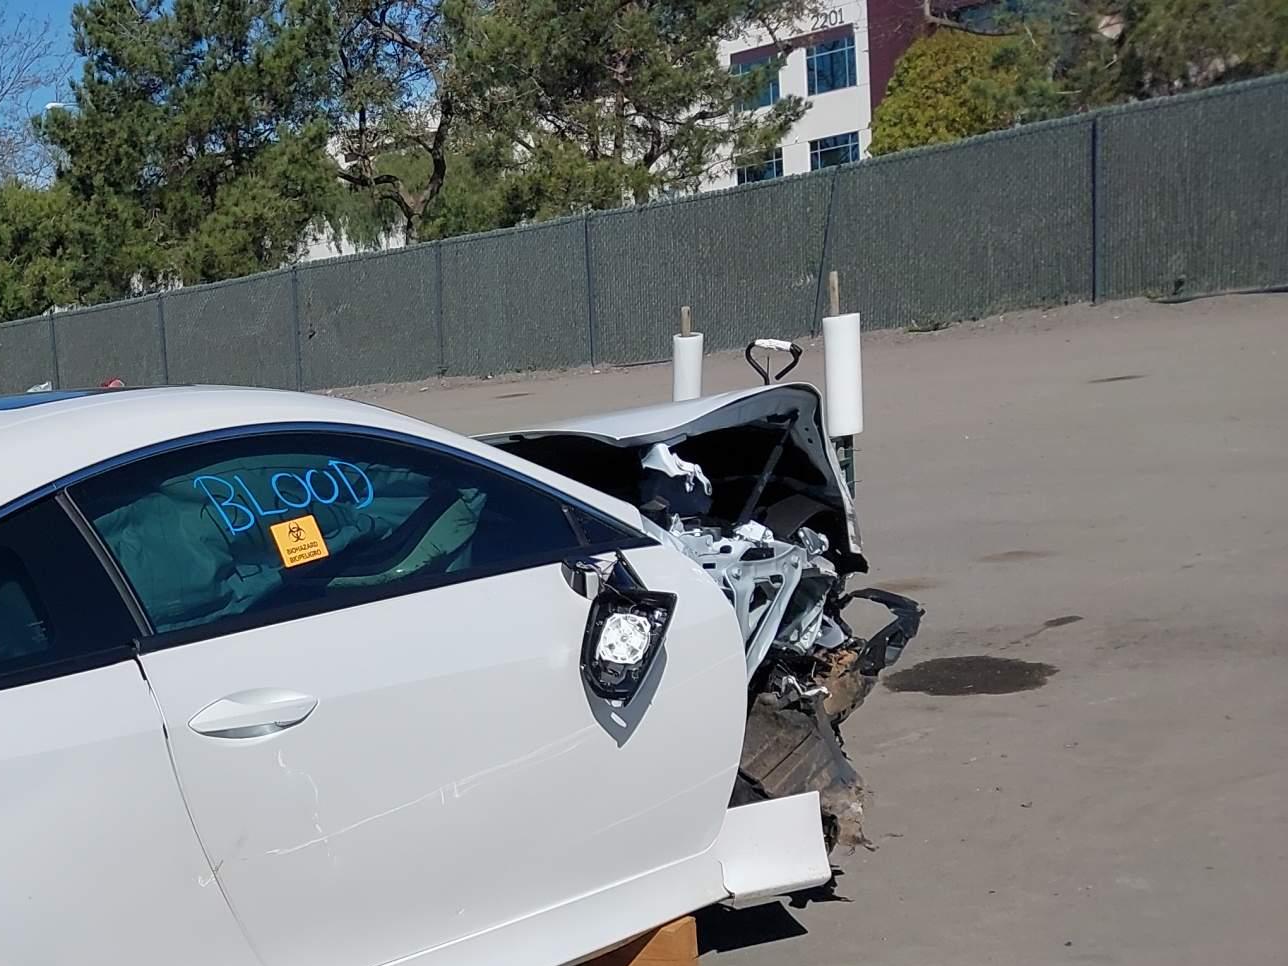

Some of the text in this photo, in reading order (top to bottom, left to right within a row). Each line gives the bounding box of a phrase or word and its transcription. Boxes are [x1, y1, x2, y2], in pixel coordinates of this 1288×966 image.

[810, 8, 845, 31] 2201
[193, 460, 374, 536] BLOOD
[286, 541, 319, 555] BIOHAZARD
[289, 549, 322, 564] BIOPELIGRO
